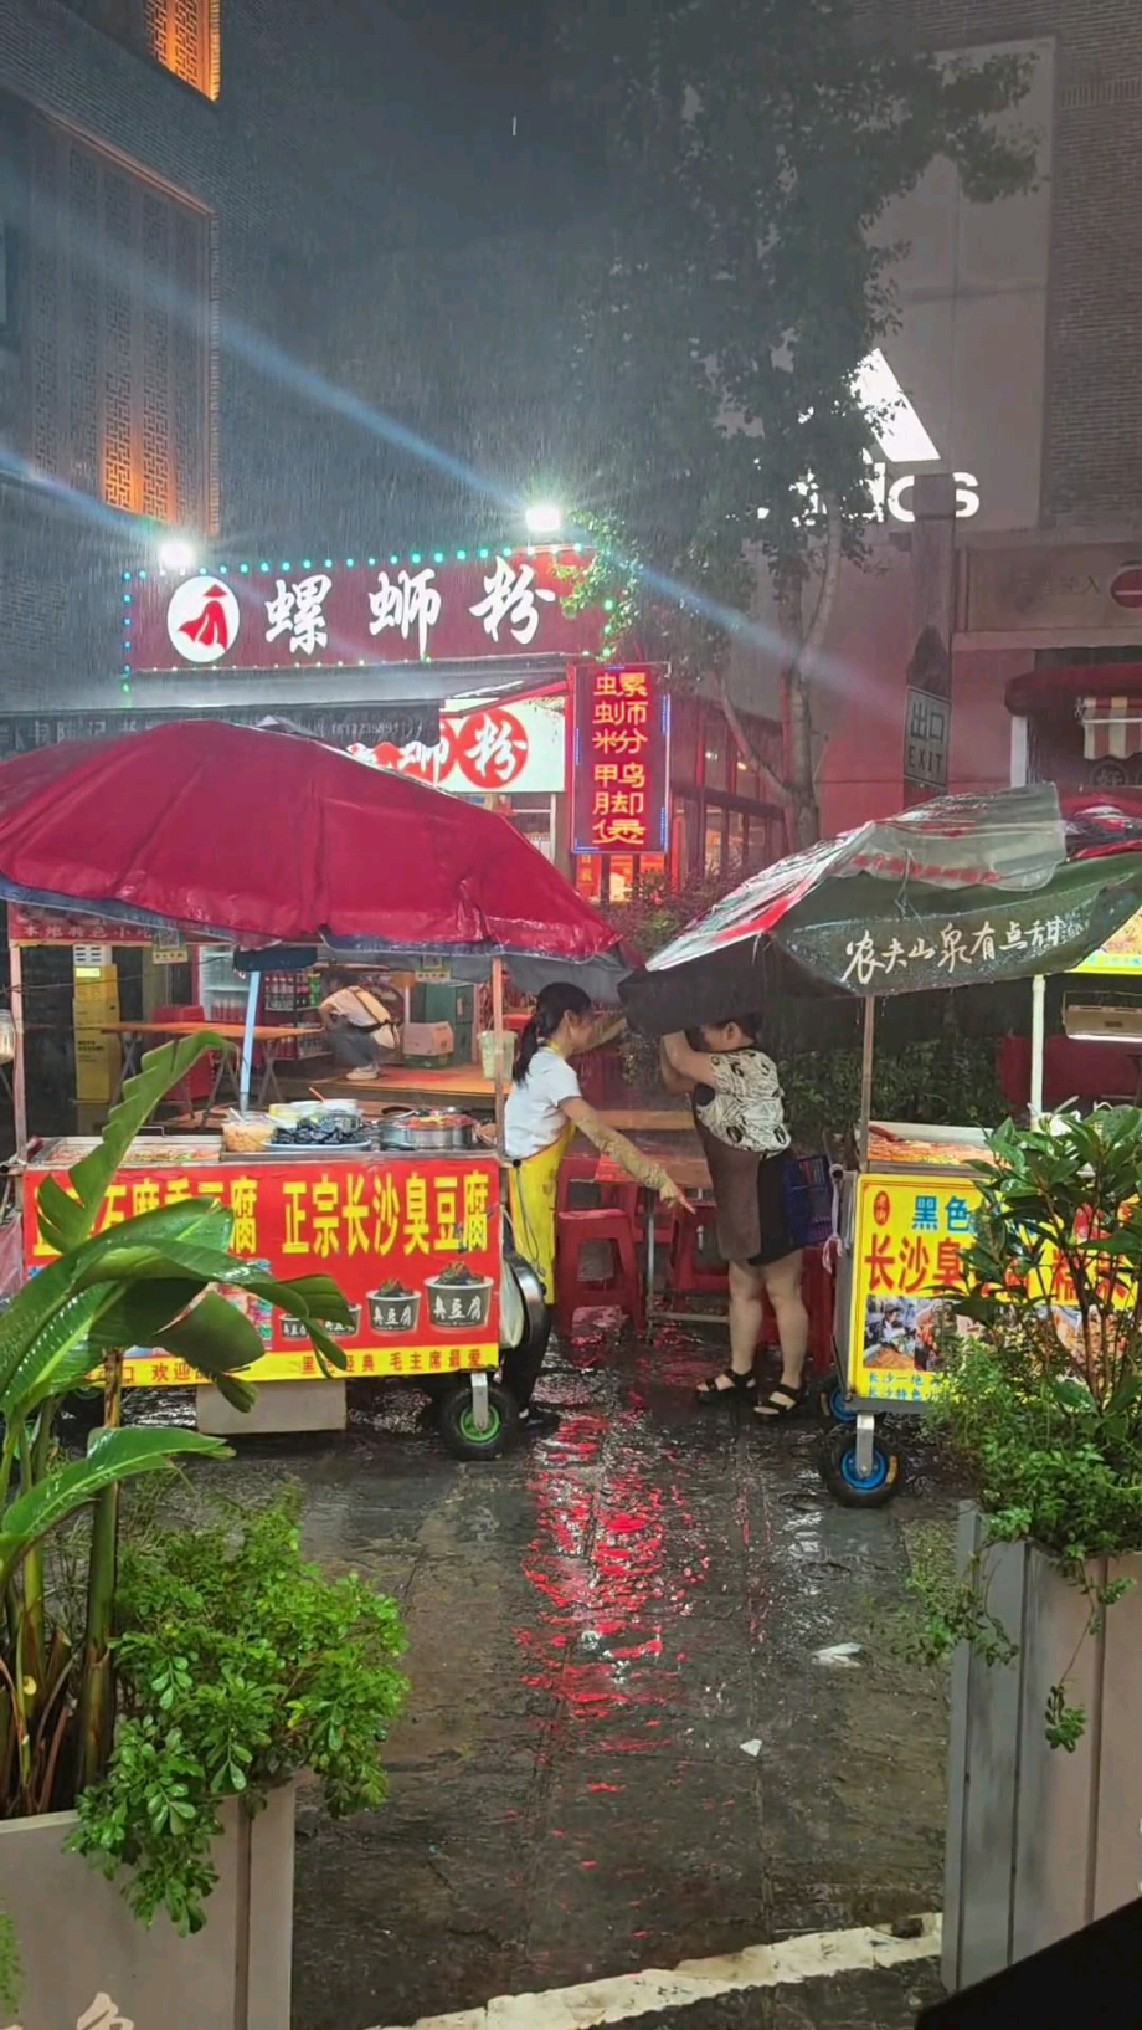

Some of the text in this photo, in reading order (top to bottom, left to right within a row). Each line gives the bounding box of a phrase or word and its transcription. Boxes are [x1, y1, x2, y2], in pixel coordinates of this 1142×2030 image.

[264, 556, 555, 661] 螺蛳粉
[911, 701, 944, 742] 出口
[909, 745, 942, 774] EXIT
[840, 915, 1063, 985] 农夫山泉有点甜
[282, 1169, 489, 1257] 正宗长沙臭豆腐
